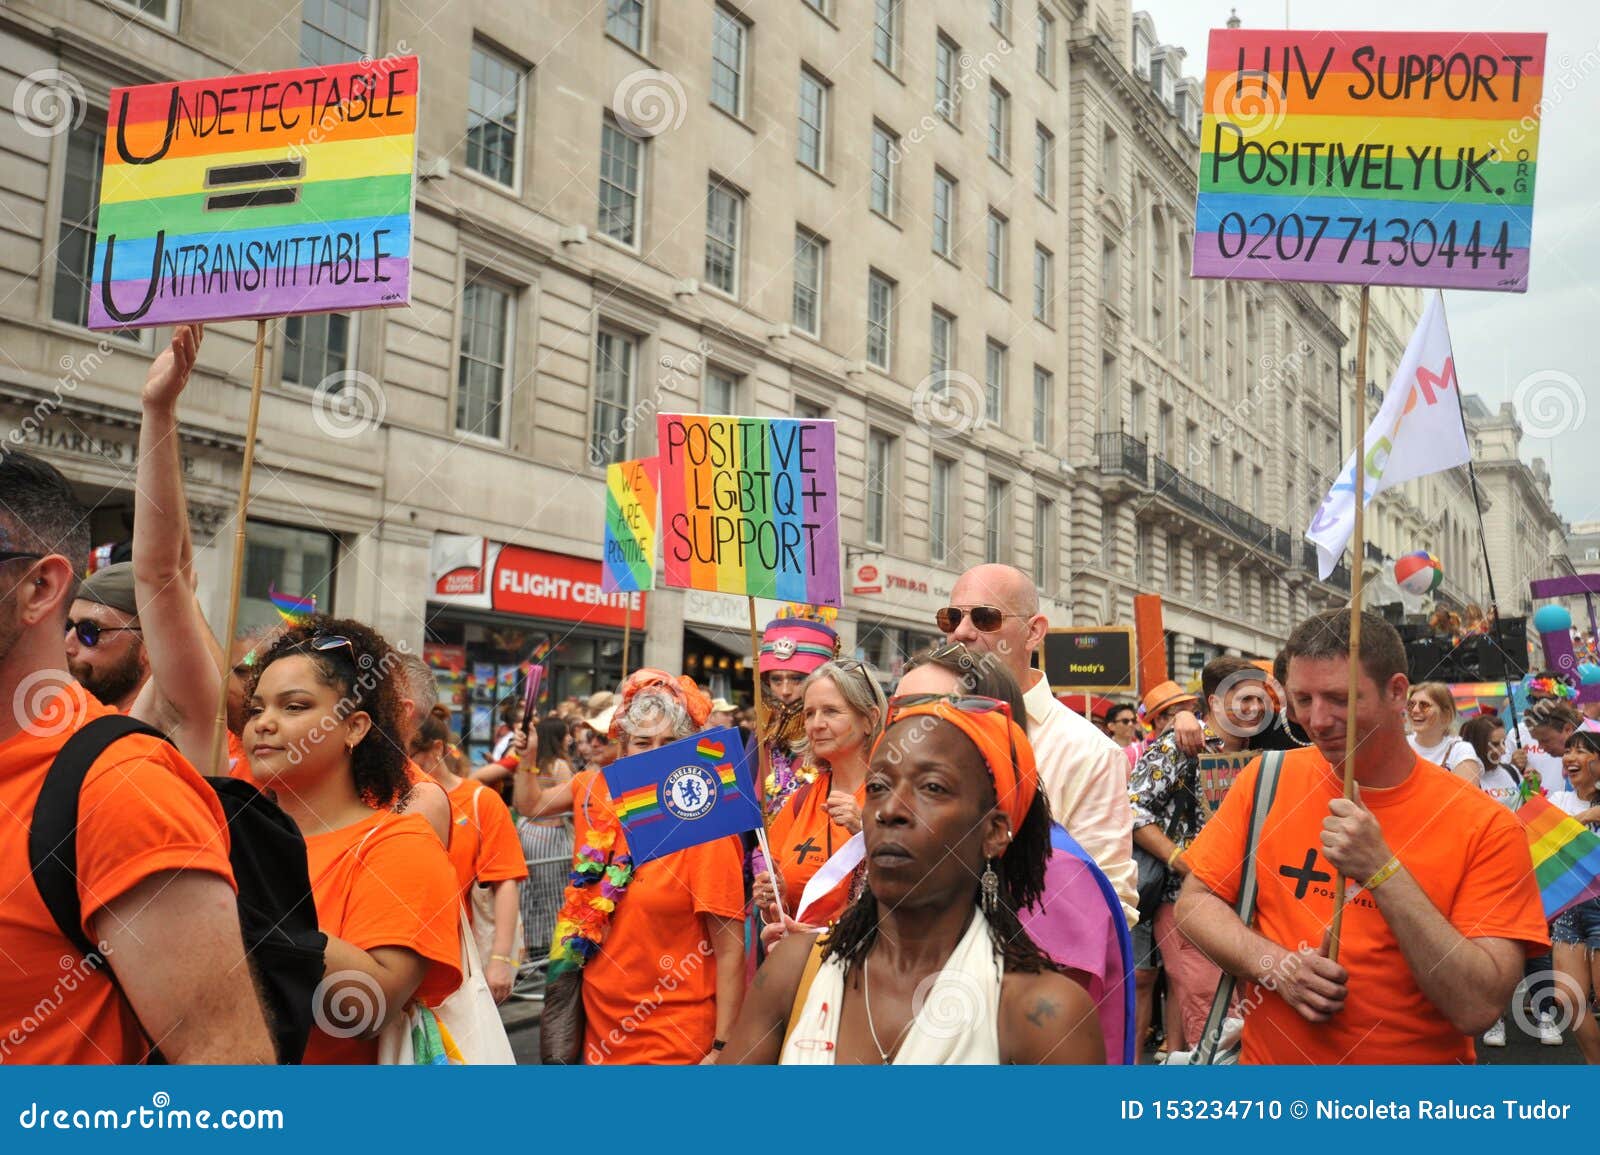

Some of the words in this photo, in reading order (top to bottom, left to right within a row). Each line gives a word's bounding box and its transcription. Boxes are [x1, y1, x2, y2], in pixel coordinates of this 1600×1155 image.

[1235, 46, 1335, 100] HIV
[1348, 46, 1533, 103] SUPPORT
[116, 69, 409, 164] UNDETECTABLE
[1516, 149, 1529, 193] ORG
[1218, 212, 1513, 270] 02077130444
[101, 230, 391, 322] UNTRANSMITTABLE
[668, 421, 816, 473] POSITIVE
[622, 464, 643, 492] WE
[695, 471, 826, 514] LGBTQ+
[617, 504, 641, 531] ARE
[608, 537, 647, 563] POSITIVE
[672, 514, 821, 576] SUPPORT
[500, 569, 570, 600] FLIGHT
[571, 582, 641, 611] CENTRE
[886, 574, 928, 594] yman
[1069, 663, 1105, 675] Moody's
[669, 767, 703, 784] CHELSEA
